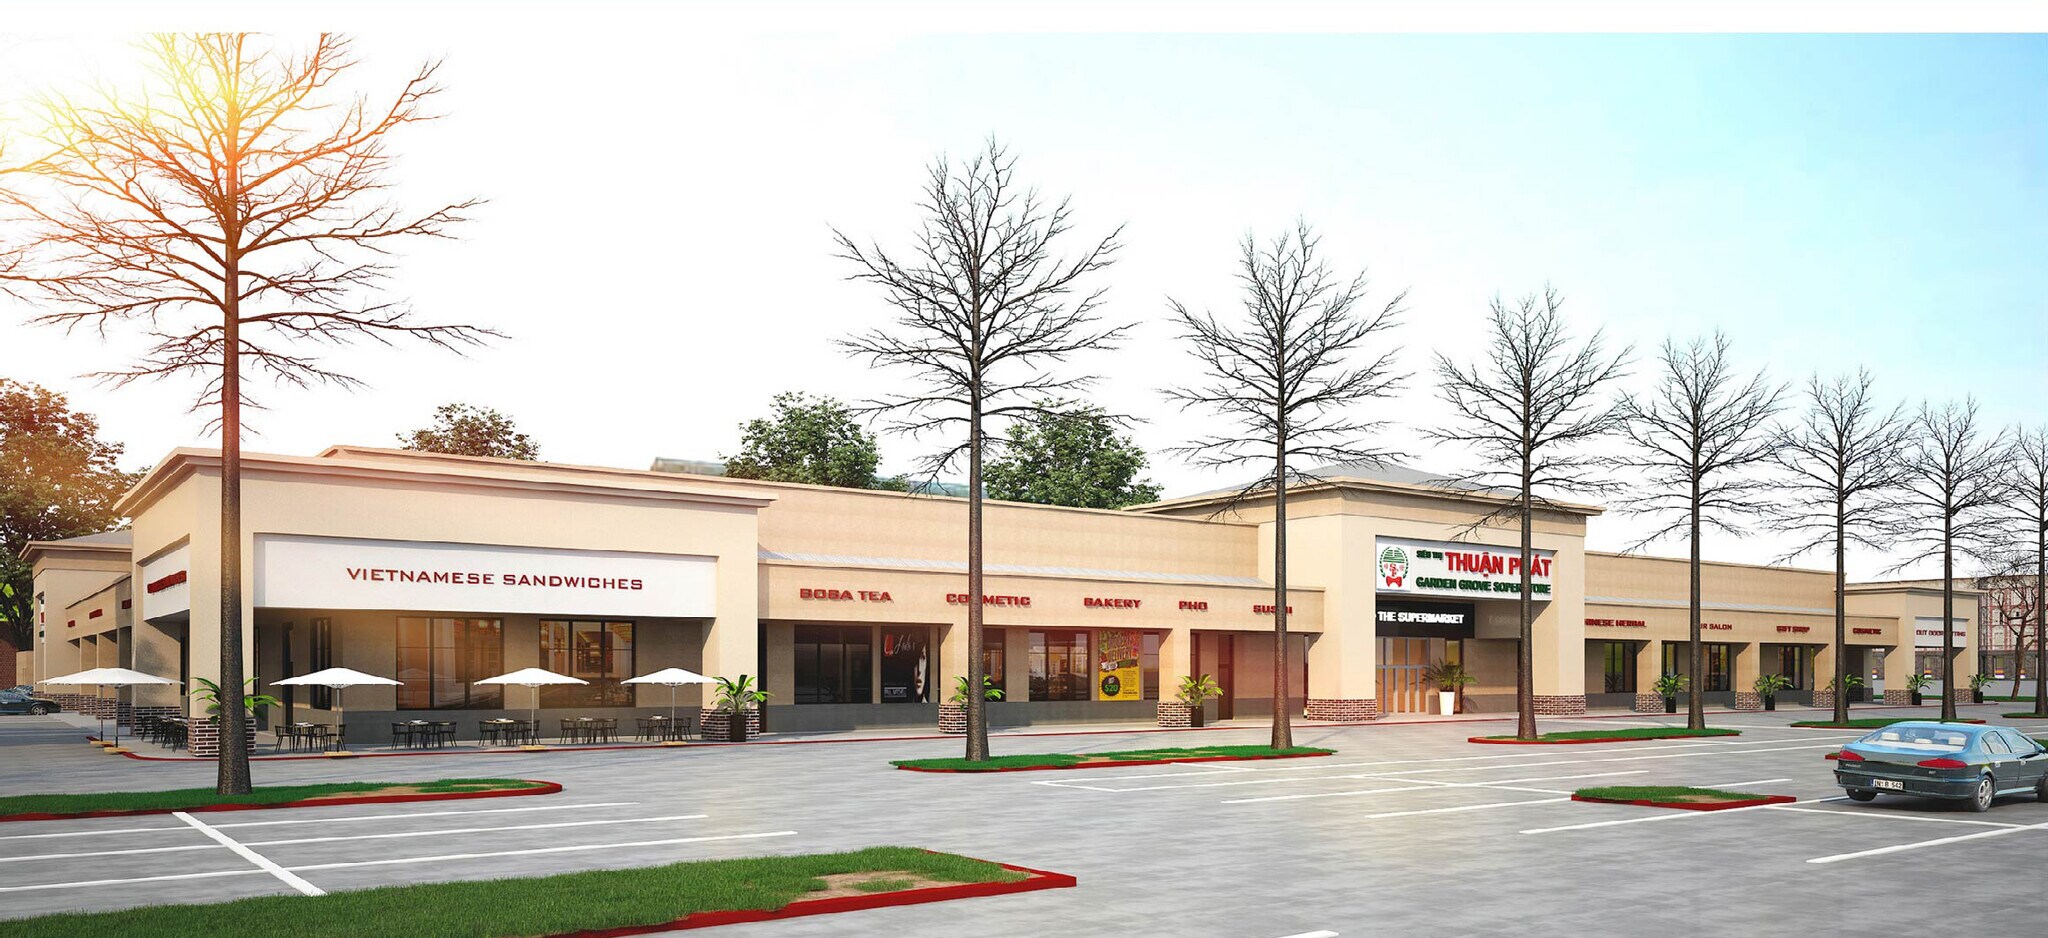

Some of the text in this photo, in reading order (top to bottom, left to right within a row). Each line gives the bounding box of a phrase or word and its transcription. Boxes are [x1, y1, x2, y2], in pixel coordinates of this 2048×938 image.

[1444, 551, 1504, 577] THUẬN
[346, 567, 643, 590] VIETNAMESE SANDWICHES
[1415, 576, 1457, 590] GARDEN
[1458, 579, 1492, 592] GROVE
[799, 588, 893, 601] BOBA TEA
[946, 593, 1031, 606] COMETIC
[1083, 597, 1141, 608] BAKERY
[1178, 600, 1208, 610] PHO
[1377, 611, 1465, 624] THE SUPERMARKET
[1709, 623, 1733, 631] SALON
